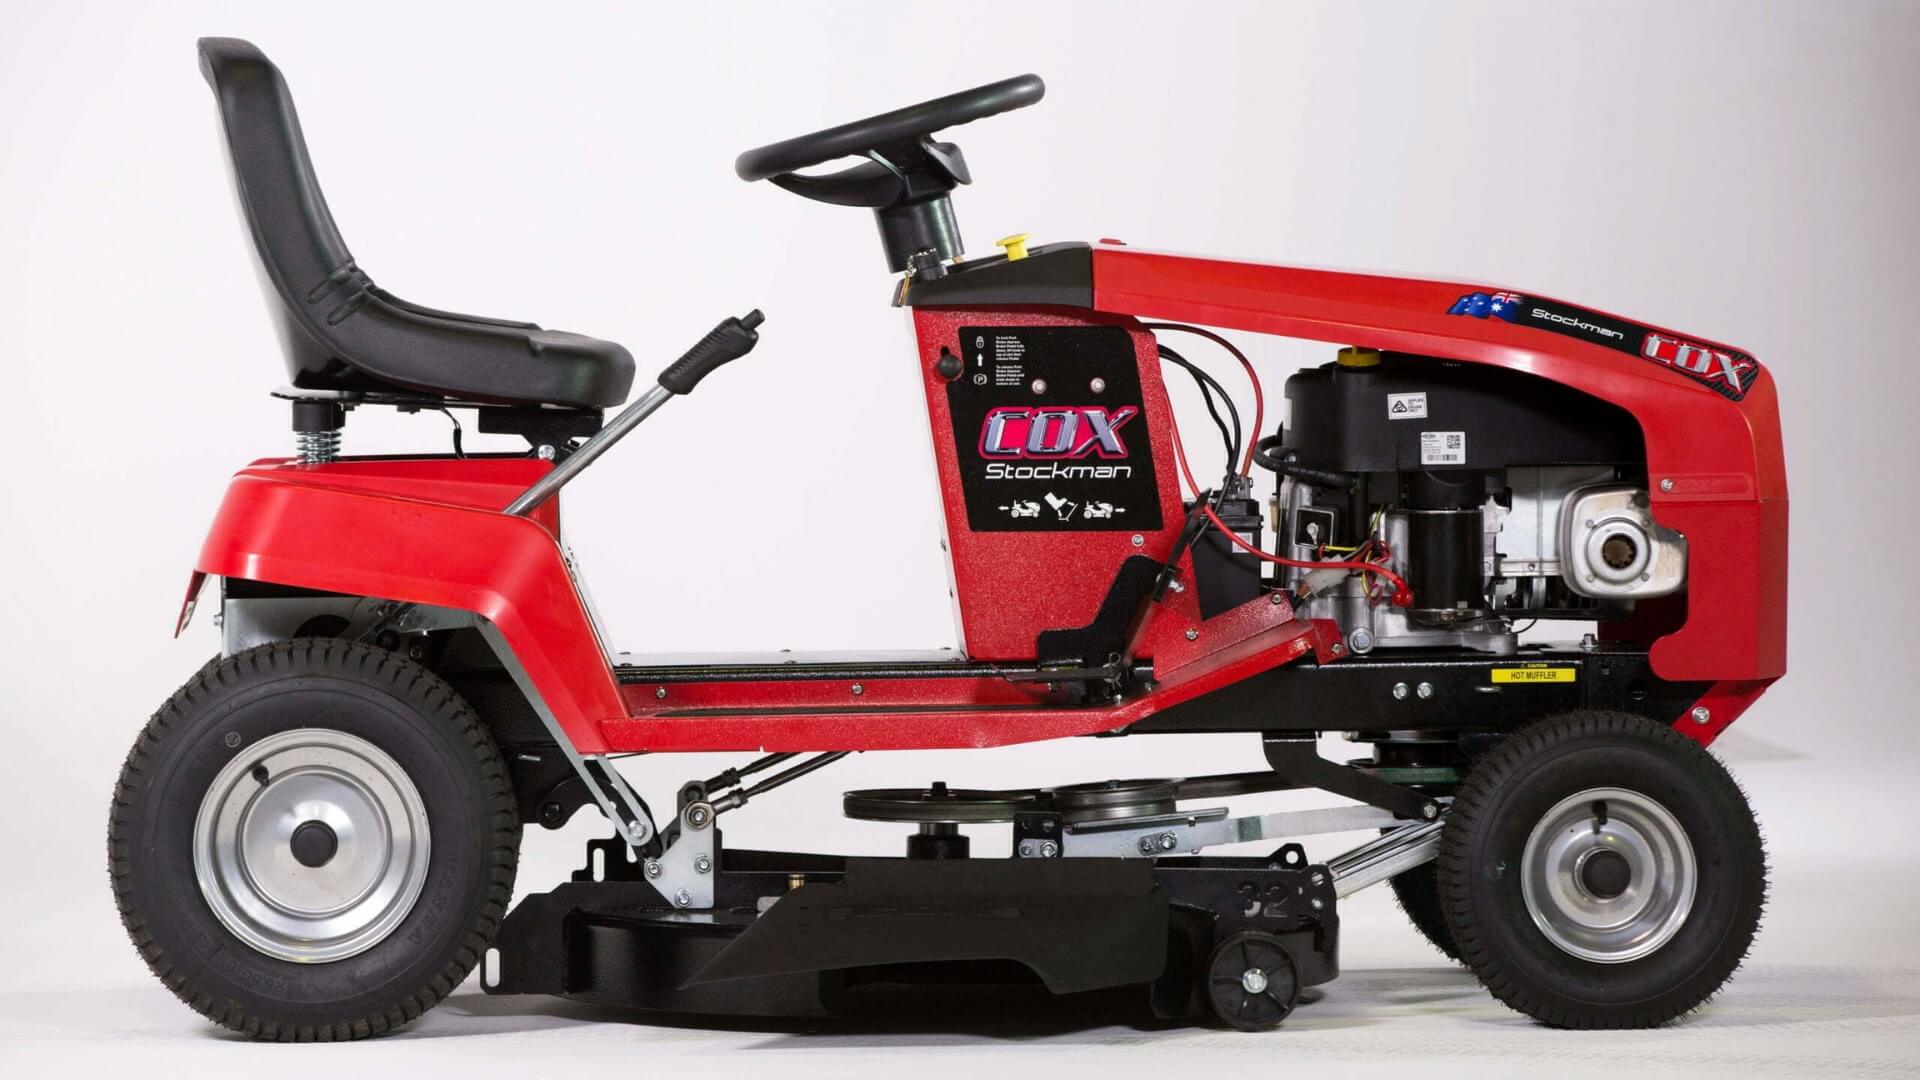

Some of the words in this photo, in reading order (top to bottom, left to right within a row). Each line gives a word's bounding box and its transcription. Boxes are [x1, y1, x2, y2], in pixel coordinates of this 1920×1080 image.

[1531, 308, 1624, 341] Stockman
[1643, 333, 1752, 392] COX
[983, 408, 1136, 456] COX
[985, 462, 1132, 480] Stockman
[1510, 672, 1524, 680] HOT
[1526, 672, 1557, 680] MUFFLER
[1238, 881, 1288, 918] 32
